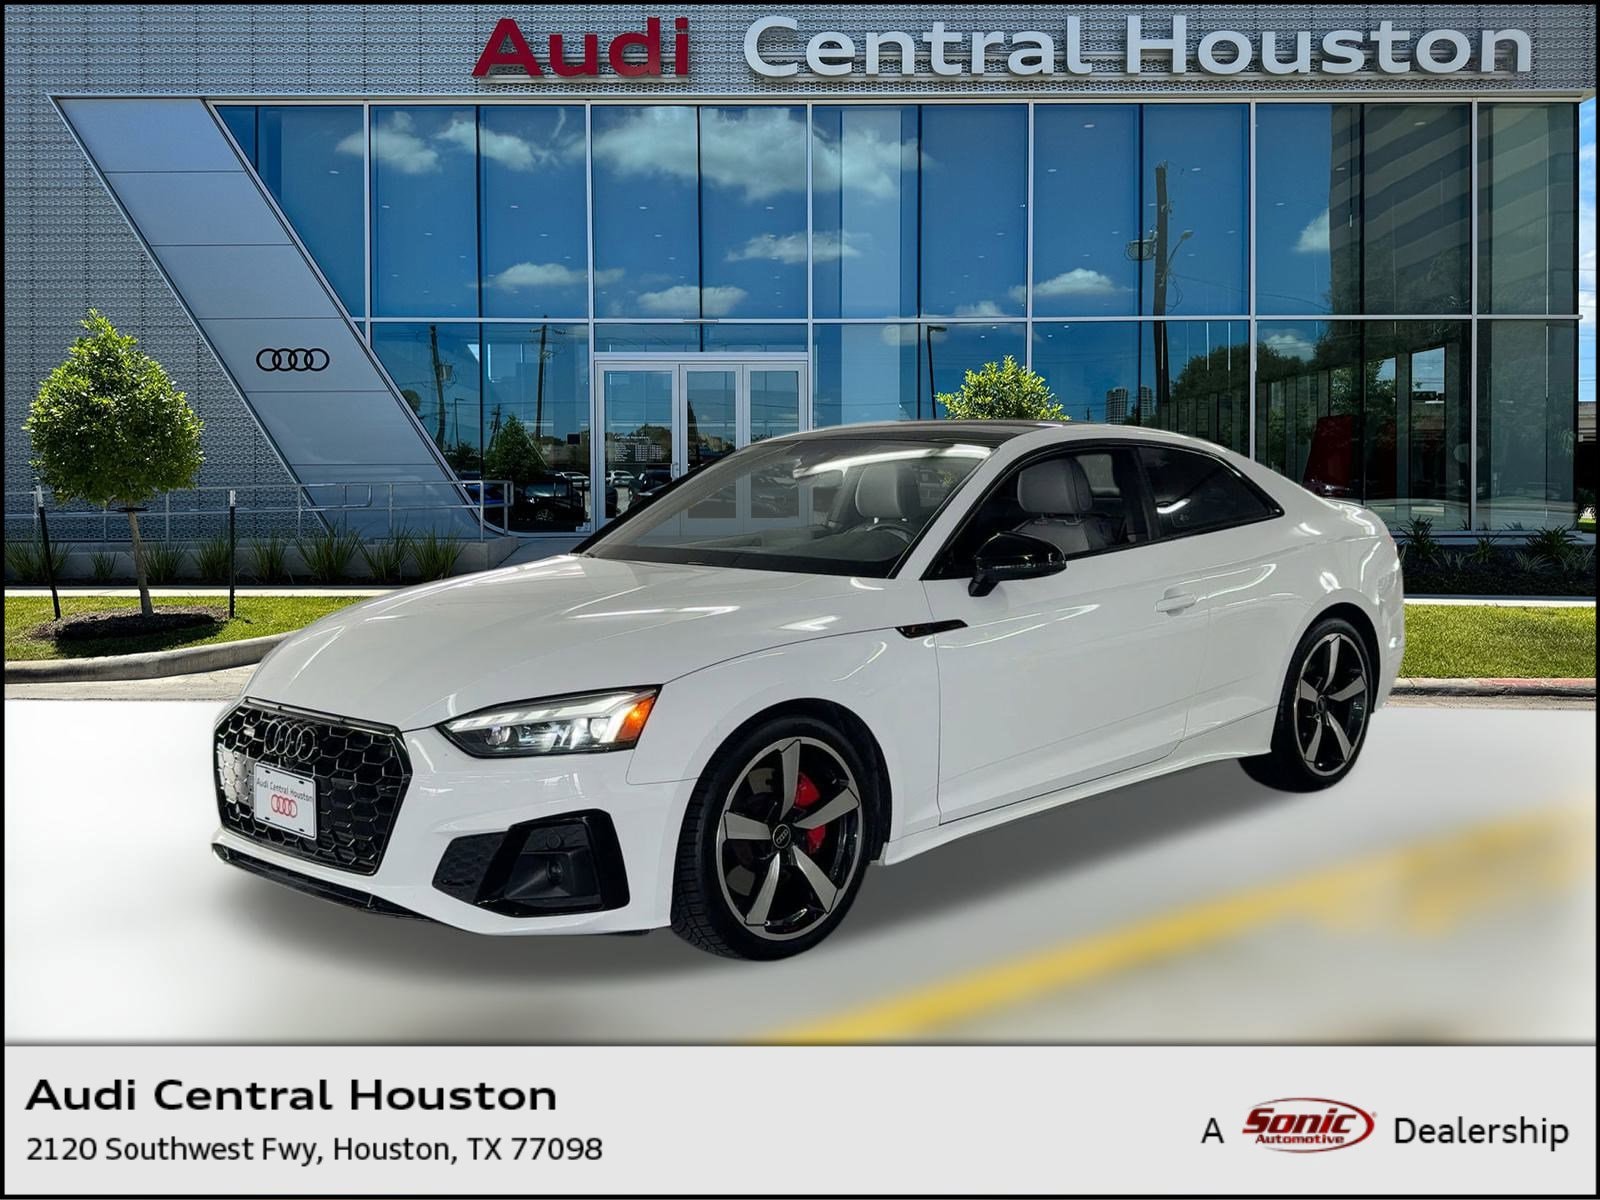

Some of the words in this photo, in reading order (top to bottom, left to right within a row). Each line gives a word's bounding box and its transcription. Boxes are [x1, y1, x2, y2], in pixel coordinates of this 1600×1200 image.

[474, 18, 690, 77] Audi
[743, 15, 1093, 77] Central
[1126, 14, 1532, 75] Houston
[256, 777, 269, 789] Audi
[270, 781, 289, 795] Central
[290, 789, 313, 802] Houston
